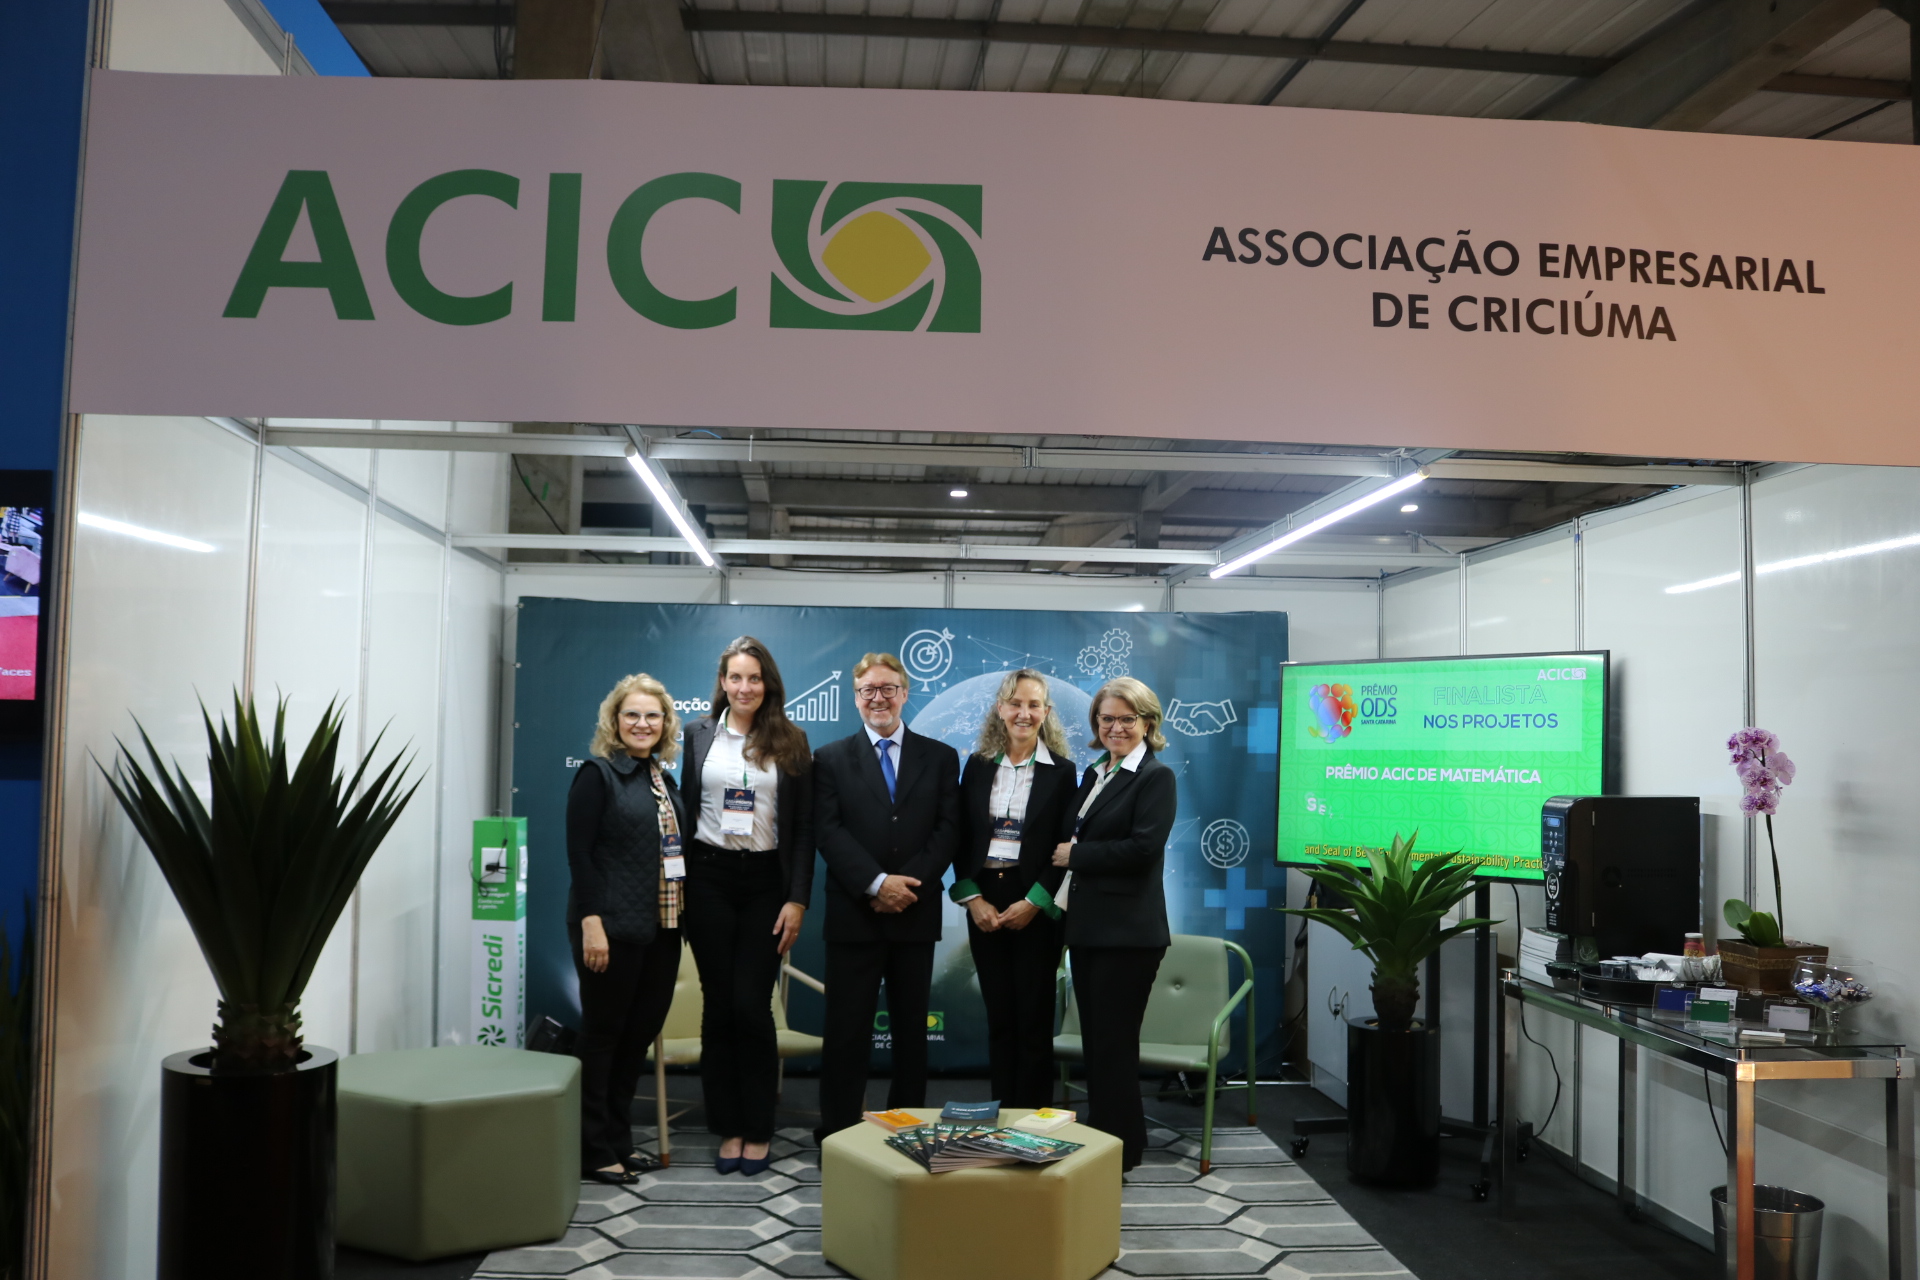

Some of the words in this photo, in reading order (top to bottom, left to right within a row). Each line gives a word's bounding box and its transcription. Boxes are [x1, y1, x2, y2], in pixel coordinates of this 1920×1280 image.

[222, 168, 742, 330] ACIC
[1202, 226, 1521, 284] ASSOCIAÇÃO
[1538, 242, 1826, 295] EMPRESARIAL
[1372, 292, 1430, 330] DE
[1447, 291, 1677, 342] CRICIÚMA
[1537, 668, 1571, 682] ACIC
[1361, 683, 1398, 696] PRÊMIO
[1433, 684, 1548, 706] FINALISTA
[1361, 697, 1398, 717] ODS
[1424, 714, 1458, 729] NOS
[1462, 713, 1559, 729] PROJETOS
[1325, 763, 1379, 780] PRÊMIO
[1381, 767, 1415, 782] ACIC
[1417, 768, 1438, 782] DE
[1440, 766, 1542, 784] MATEMÁTICA
[1304, 844, 1320, 855] and
[1322, 844, 1340, 856] Seal
[1343, 845, 1352, 857] of
[1513, 856, 1543, 869] Practi
[482, 934, 504, 1019] Sicredi
